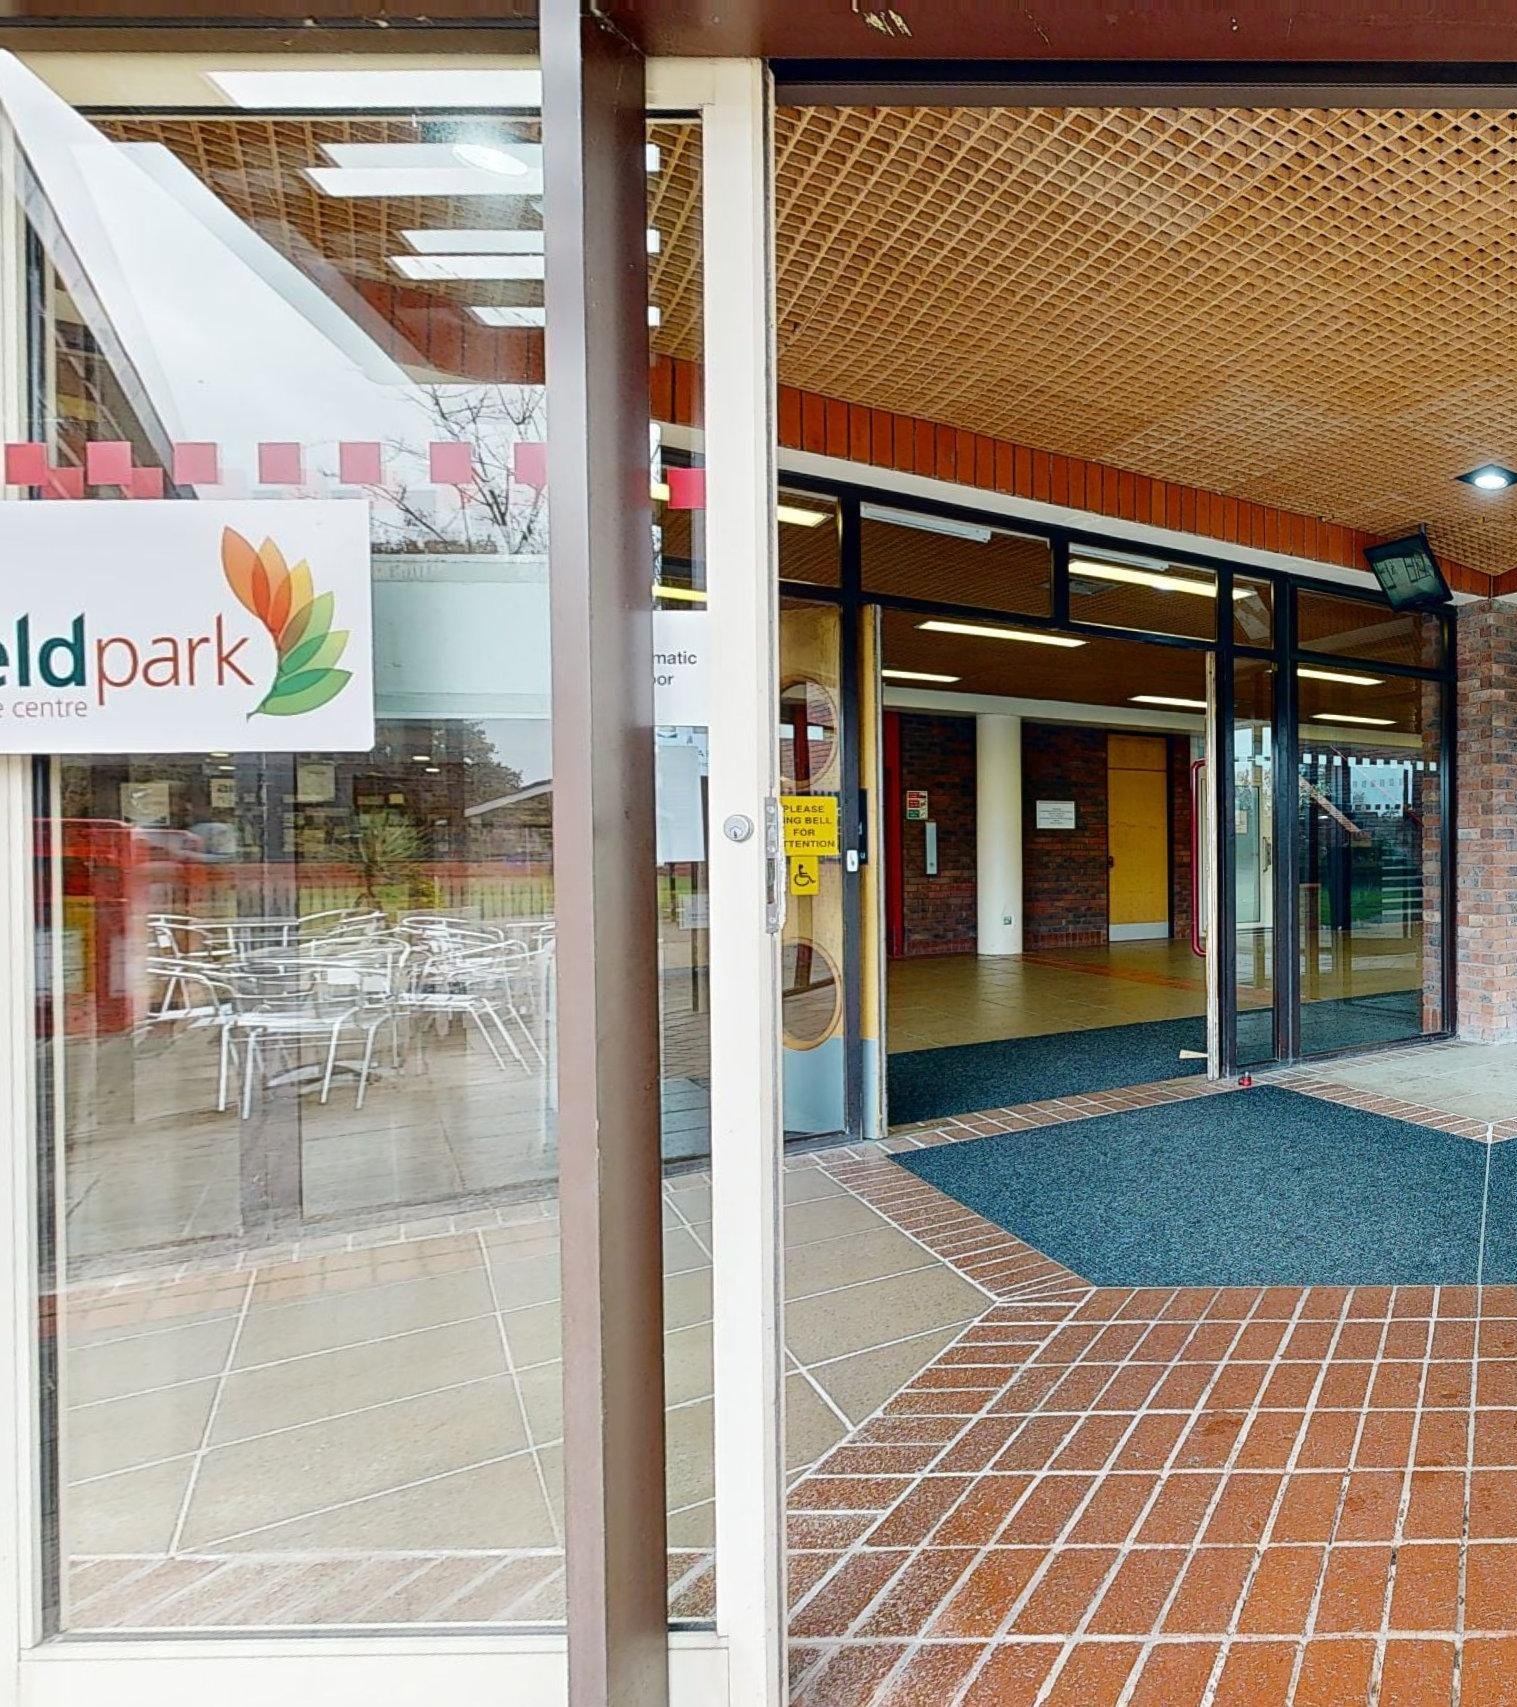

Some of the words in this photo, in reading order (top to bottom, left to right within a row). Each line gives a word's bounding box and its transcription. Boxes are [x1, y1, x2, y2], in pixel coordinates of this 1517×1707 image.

[0, 612, 254, 706] ldpark
[12, 699, 88, 718] centre
[783, 804, 825, 813] PLEASE
[783, 816, 802, 824] ING
[805, 816, 832, 825] BELL
[793, 828, 816, 836] FOR
[783, 840, 836, 848] TTENTION
